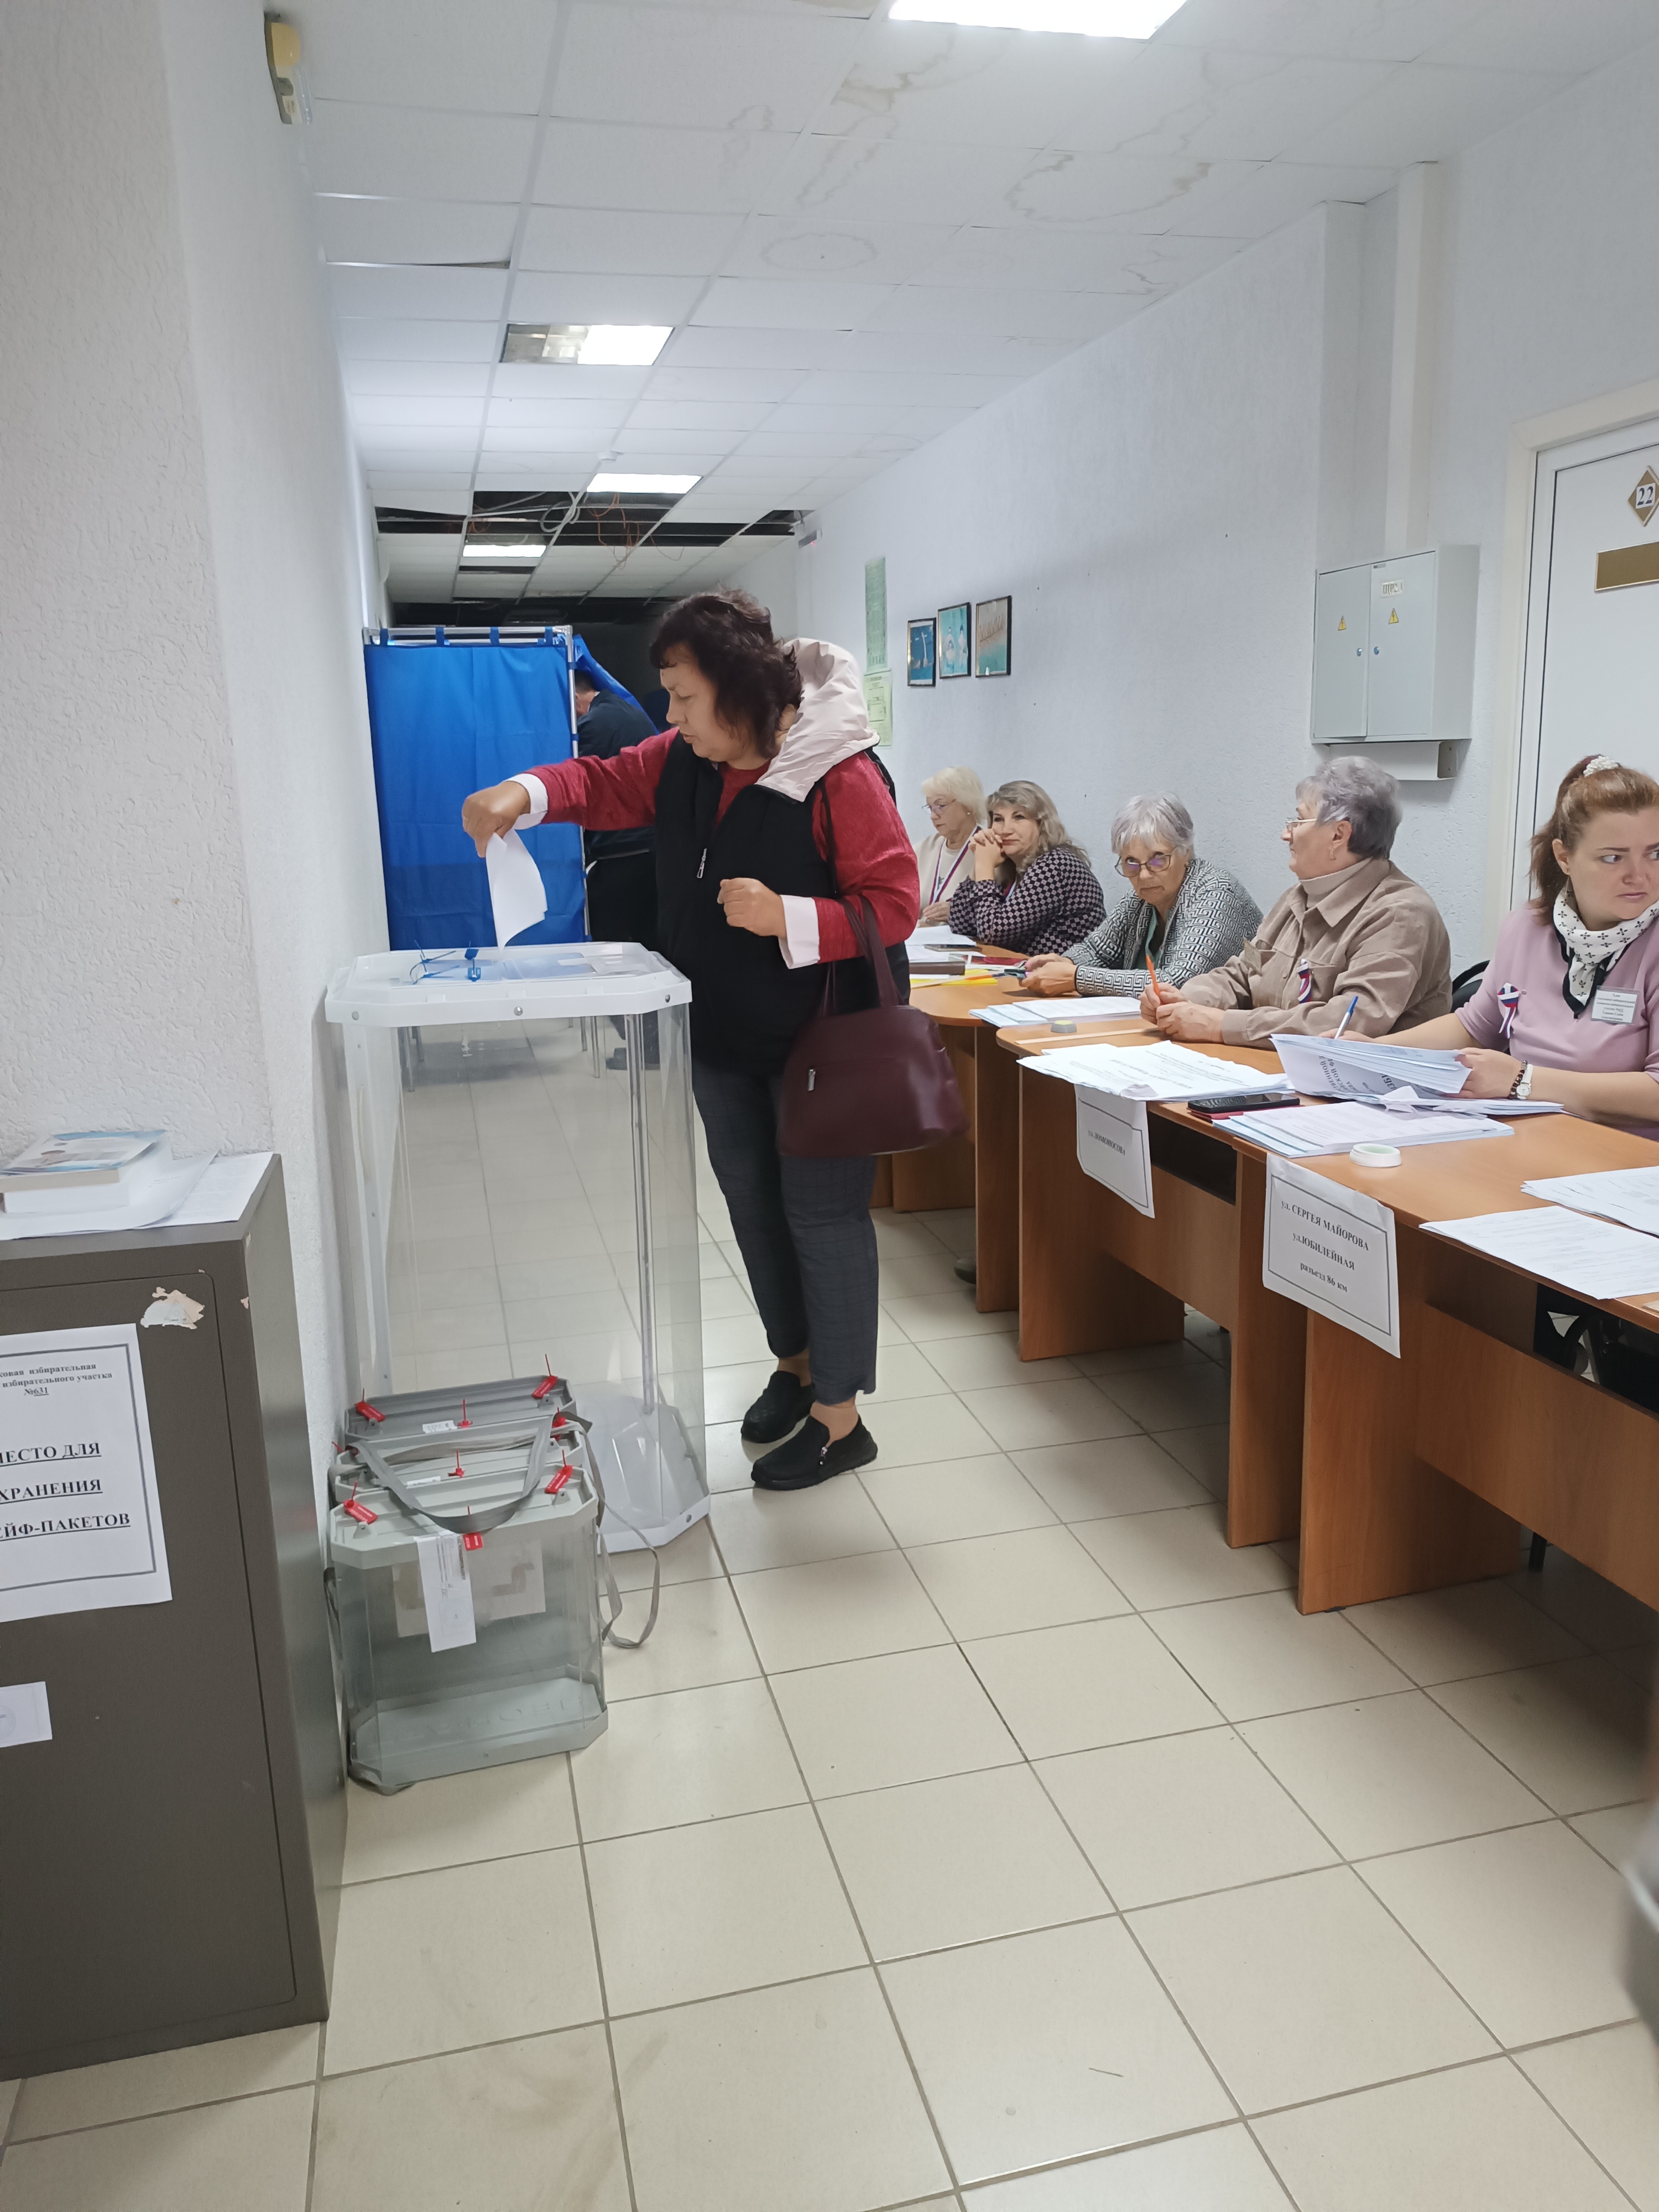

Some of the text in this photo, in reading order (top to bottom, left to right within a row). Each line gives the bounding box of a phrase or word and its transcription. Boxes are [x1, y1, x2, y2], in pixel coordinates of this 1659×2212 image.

[1637, 486, 1653, 506] 22
[1281, 1201, 1369, 1251] ул. СЕРГЕЯ МАЙОРОВА
[1300, 1262, 1347, 1292] разъезд 86 км
[2, 1373, 112, 1387] избирательного участка
[29, 1364, 96, 1375] избирательная
[24, 1387, 49, 1396] №631
[0, 1442, 100, 1464] ЕСТО ДЛЯ
[0, 1479, 101, 1501] ХРАНЕНИЯ
[0, 1513, 130, 1538] ЙФ-ПАКЕТОВ
